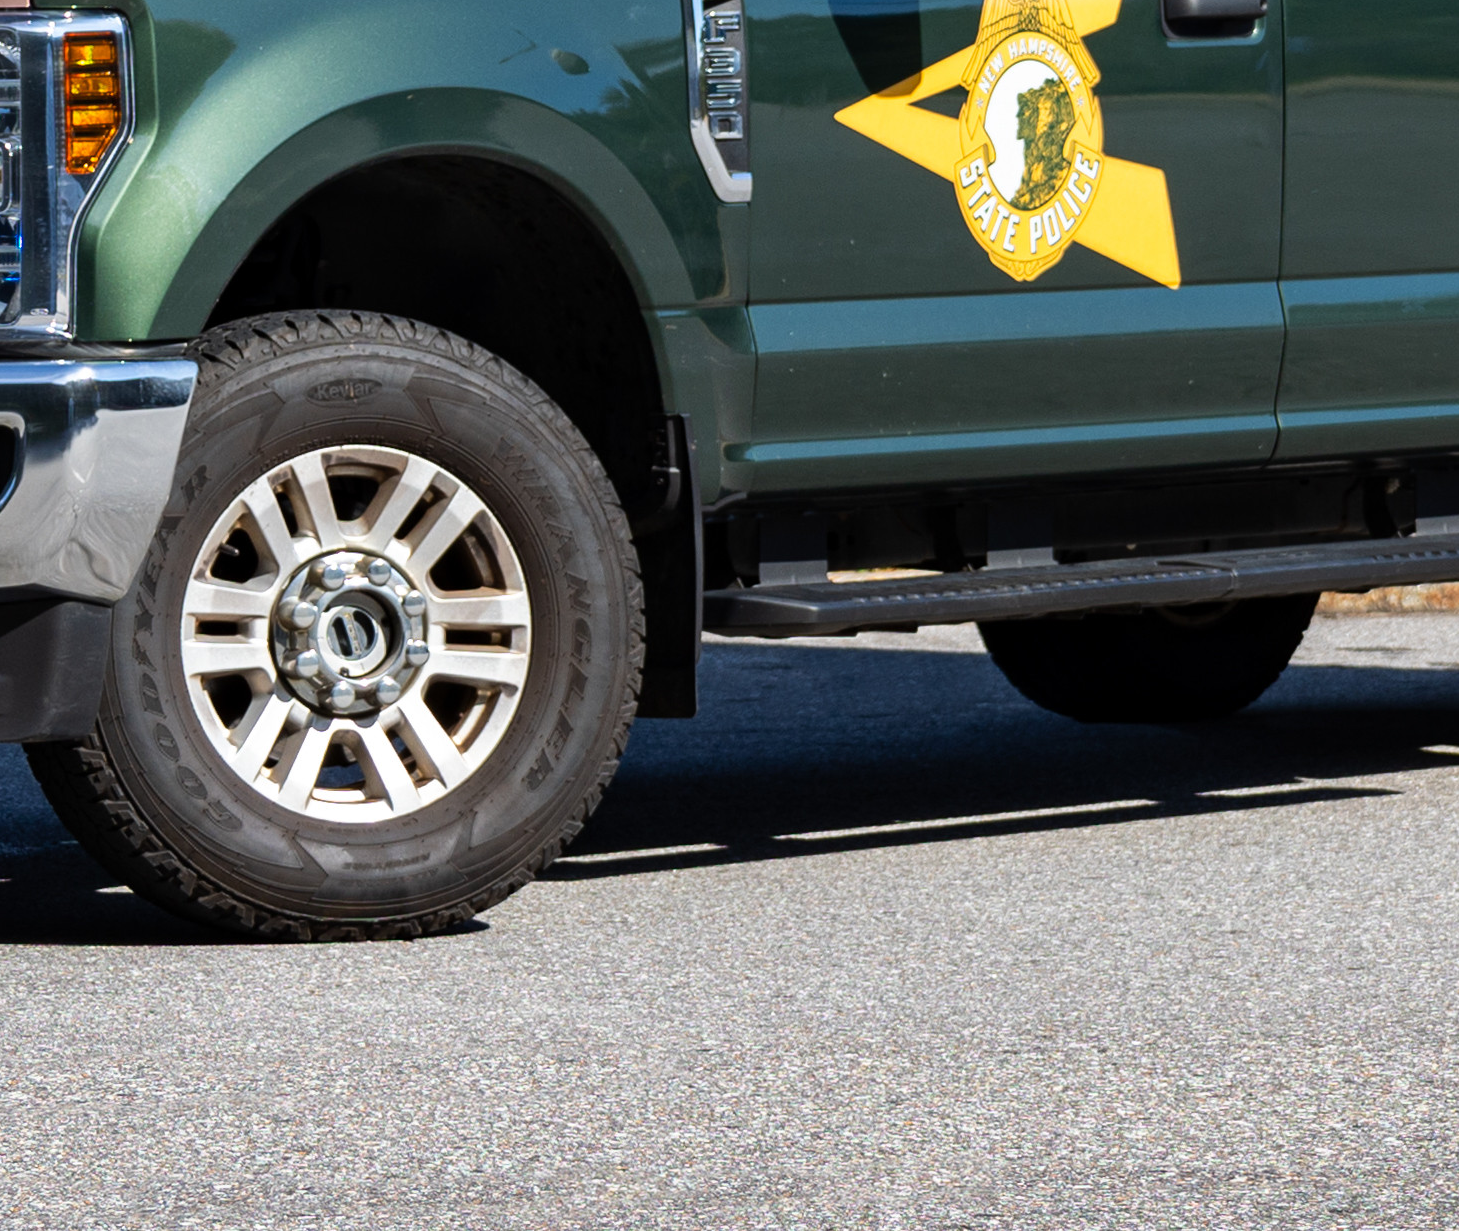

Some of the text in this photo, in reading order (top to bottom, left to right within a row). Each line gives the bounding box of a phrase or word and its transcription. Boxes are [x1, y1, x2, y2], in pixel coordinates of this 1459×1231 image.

[979, 37, 1081, 95] NEW HAMPSHIRE
[958, 152, 1101, 254] STATE POLICE
[317, 382, 372, 400] Kevlar
[131, 462, 242, 832] GOODYEAR
[494, 436, 594, 793] WRANGLER
